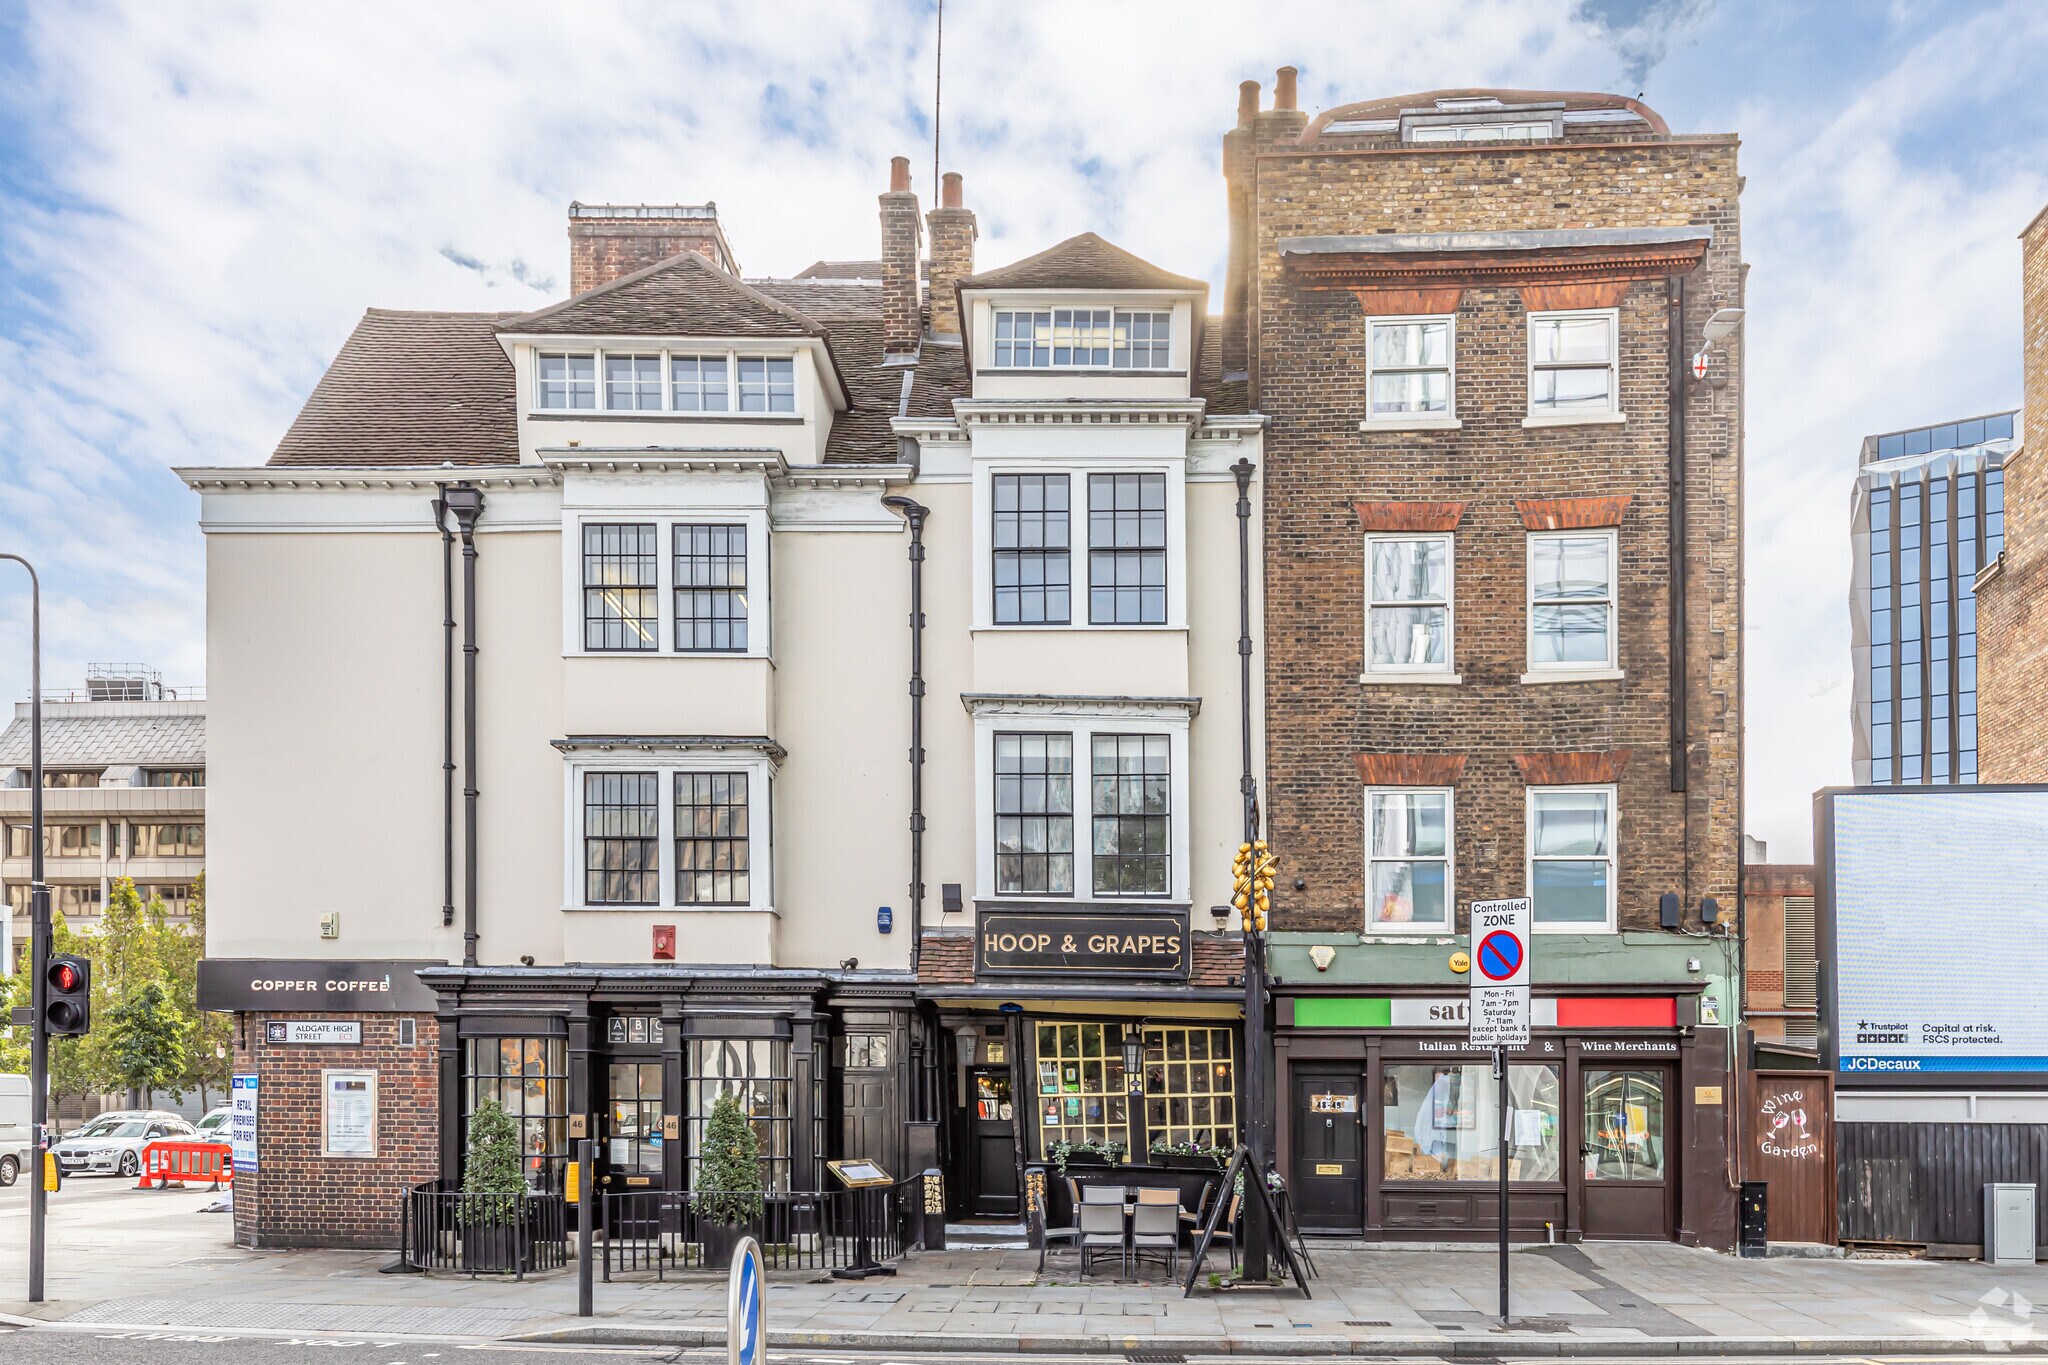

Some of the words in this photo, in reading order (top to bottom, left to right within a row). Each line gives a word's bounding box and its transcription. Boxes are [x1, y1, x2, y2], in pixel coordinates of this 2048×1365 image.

[1474, 901, 1526, 913] Controlled
[1483, 914, 1515, 926] ZONE
[985, 934, 1050, 952] HOOP
[1061, 934, 1077, 952] &
[1088, 935, 1180, 954] GRAPES
[251, 980, 317, 991] COPPER
[325, 980, 389, 992] COFFEE
[1502, 999, 1520, 1008] 7pm
[1483, 1008, 1516, 1017] Saturday
[613, 1020, 622, 1030] A
[635, 1020, 642, 1030] B
[1870, 1023, 1908, 1031] Trustpilot
[1922, 1024, 1959, 1033] Capital
[1963, 1024, 1974, 1032] at
[1977, 1024, 1997, 1032] risk.
[1496, 1033, 1527, 1041] holidays
[1922, 1035, 1948, 1044] FSCS
[1952, 1035, 2003, 1045] protected.
[1419, 1042, 1457, 1051] Italian
[1544, 1041, 1554, 1051] &
[1581, 1041, 1612, 1051] Wine
[1614, 1042, 1677, 1051] Merchants
[1848, 1058, 1921, 1070] JCDecaux
[237, 1100, 252, 1110] RETAIL
[1761, 1090, 1803, 1114] Wine
[233, 1115, 255, 1126] PREMISES
[233, 1130, 242, 1141] FOR
[243, 1131, 255, 1141] RENT
[1761, 1141, 1817, 1158] Garden
